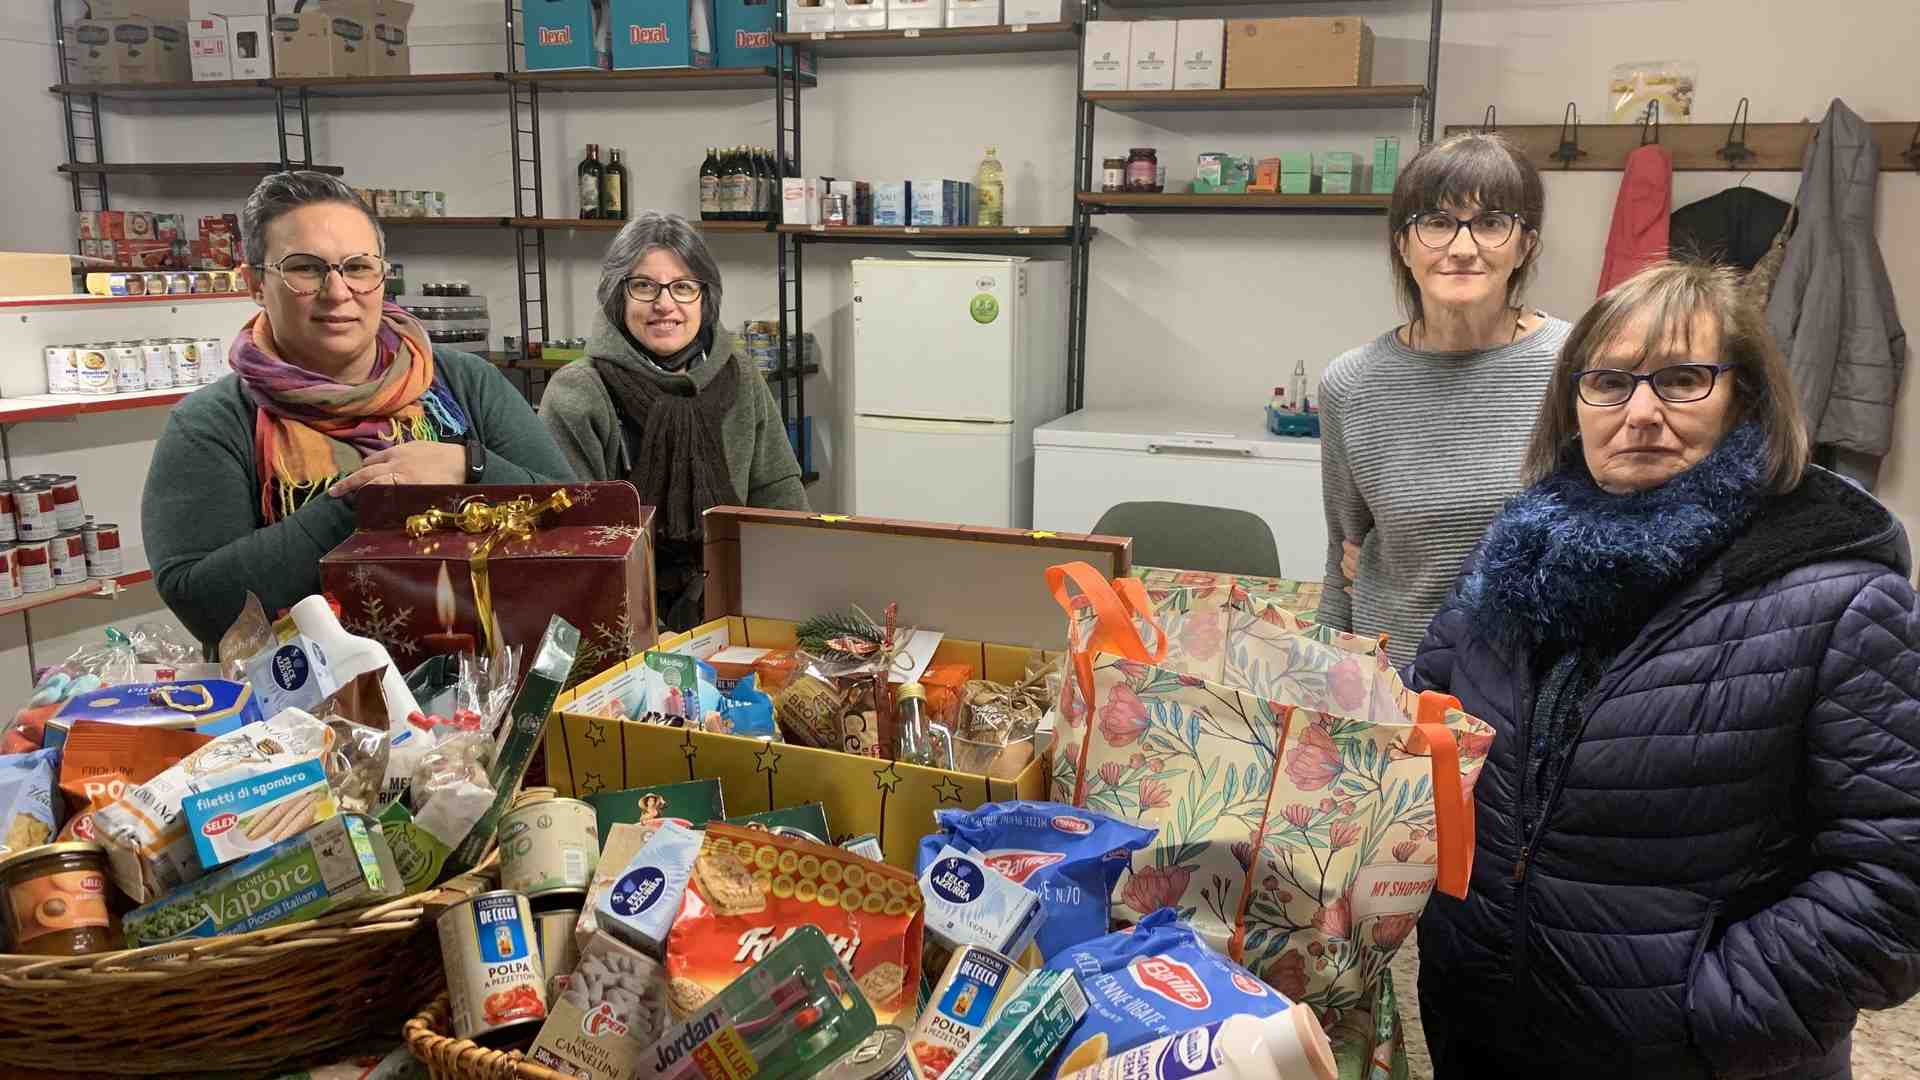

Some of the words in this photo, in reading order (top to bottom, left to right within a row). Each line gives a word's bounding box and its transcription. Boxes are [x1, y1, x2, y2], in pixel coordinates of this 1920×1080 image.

[196, 791, 235, 811] filetti
[238, 785, 249, 799] di
[252, 771, 307, 796] sgombro
[205, 814, 236, 833] SELEX
[201, 863, 312, 928] Vapore
[236, 870, 267, 893] Cotti
[1370, 881, 1390, 897] MY
[488, 962, 530, 979] POLPA
[1141, 961, 1202, 1004] Barilla
[655, 1012, 720, 1073] Jordan
[931, 1016, 972, 1043] POLPA
[716, 1031, 753, 1080] VALUE
